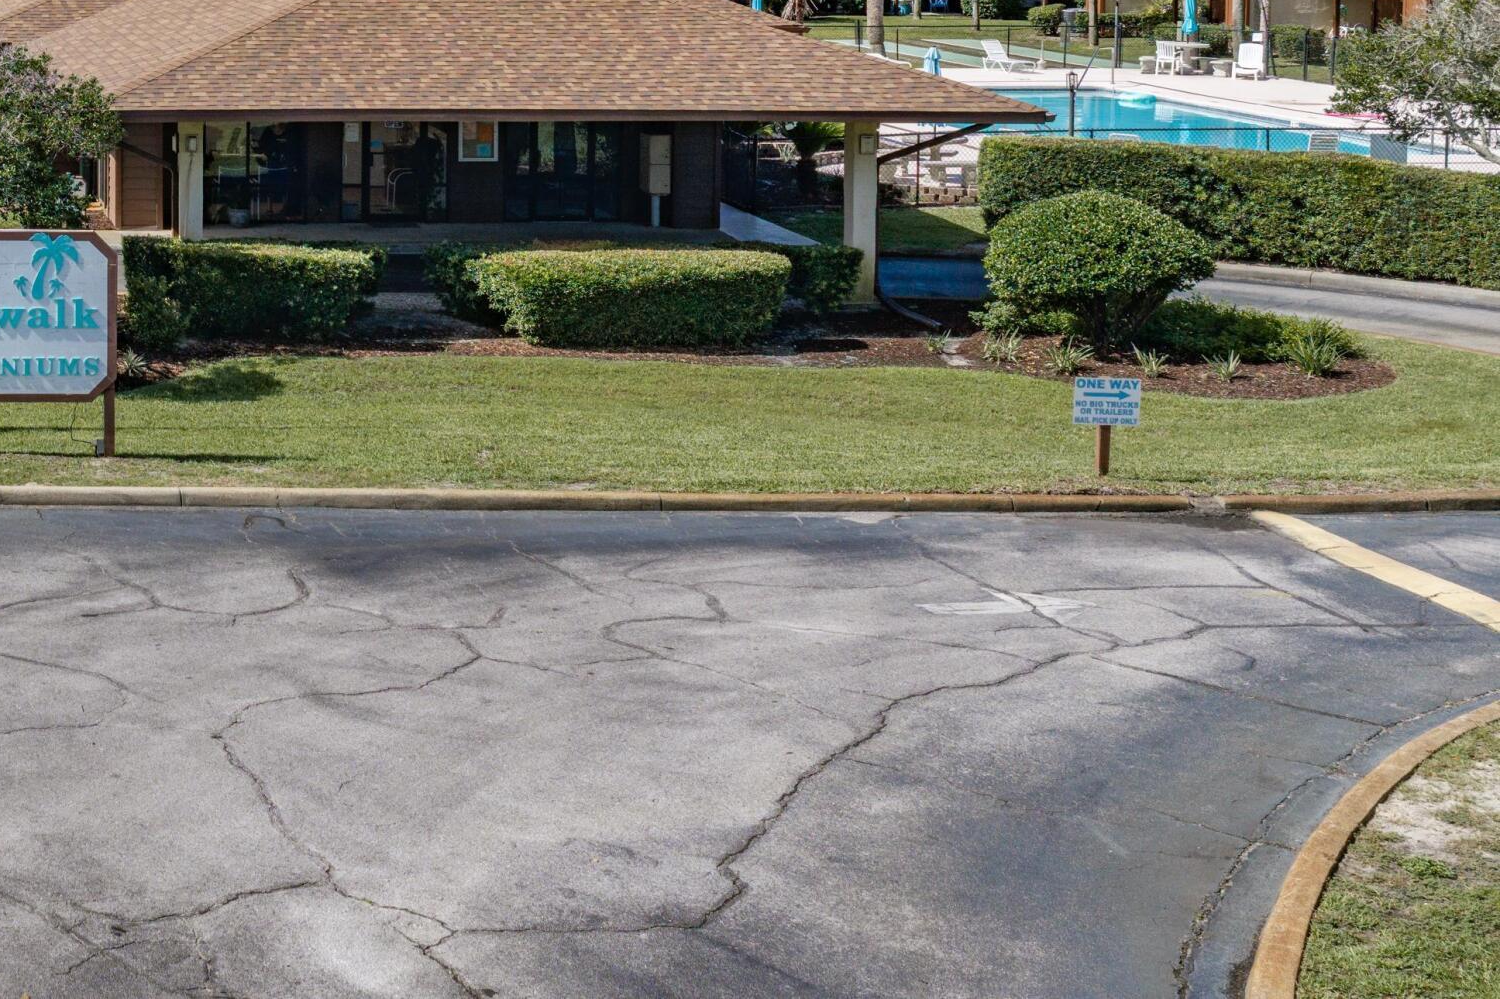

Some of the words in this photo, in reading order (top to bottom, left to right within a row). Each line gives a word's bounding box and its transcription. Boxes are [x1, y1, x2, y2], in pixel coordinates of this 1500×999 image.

[1076, 378, 1105, 389] ONE
[1109, 379, 1139, 390] WAY
[1075, 400, 1087, 408] NO
[1090, 400, 1104, 408] BIG
[1106, 401, 1139, 409] TRUCKS
[1080, 407, 1092, 415] OR
[1094, 408, 1133, 416] TRAILERS
